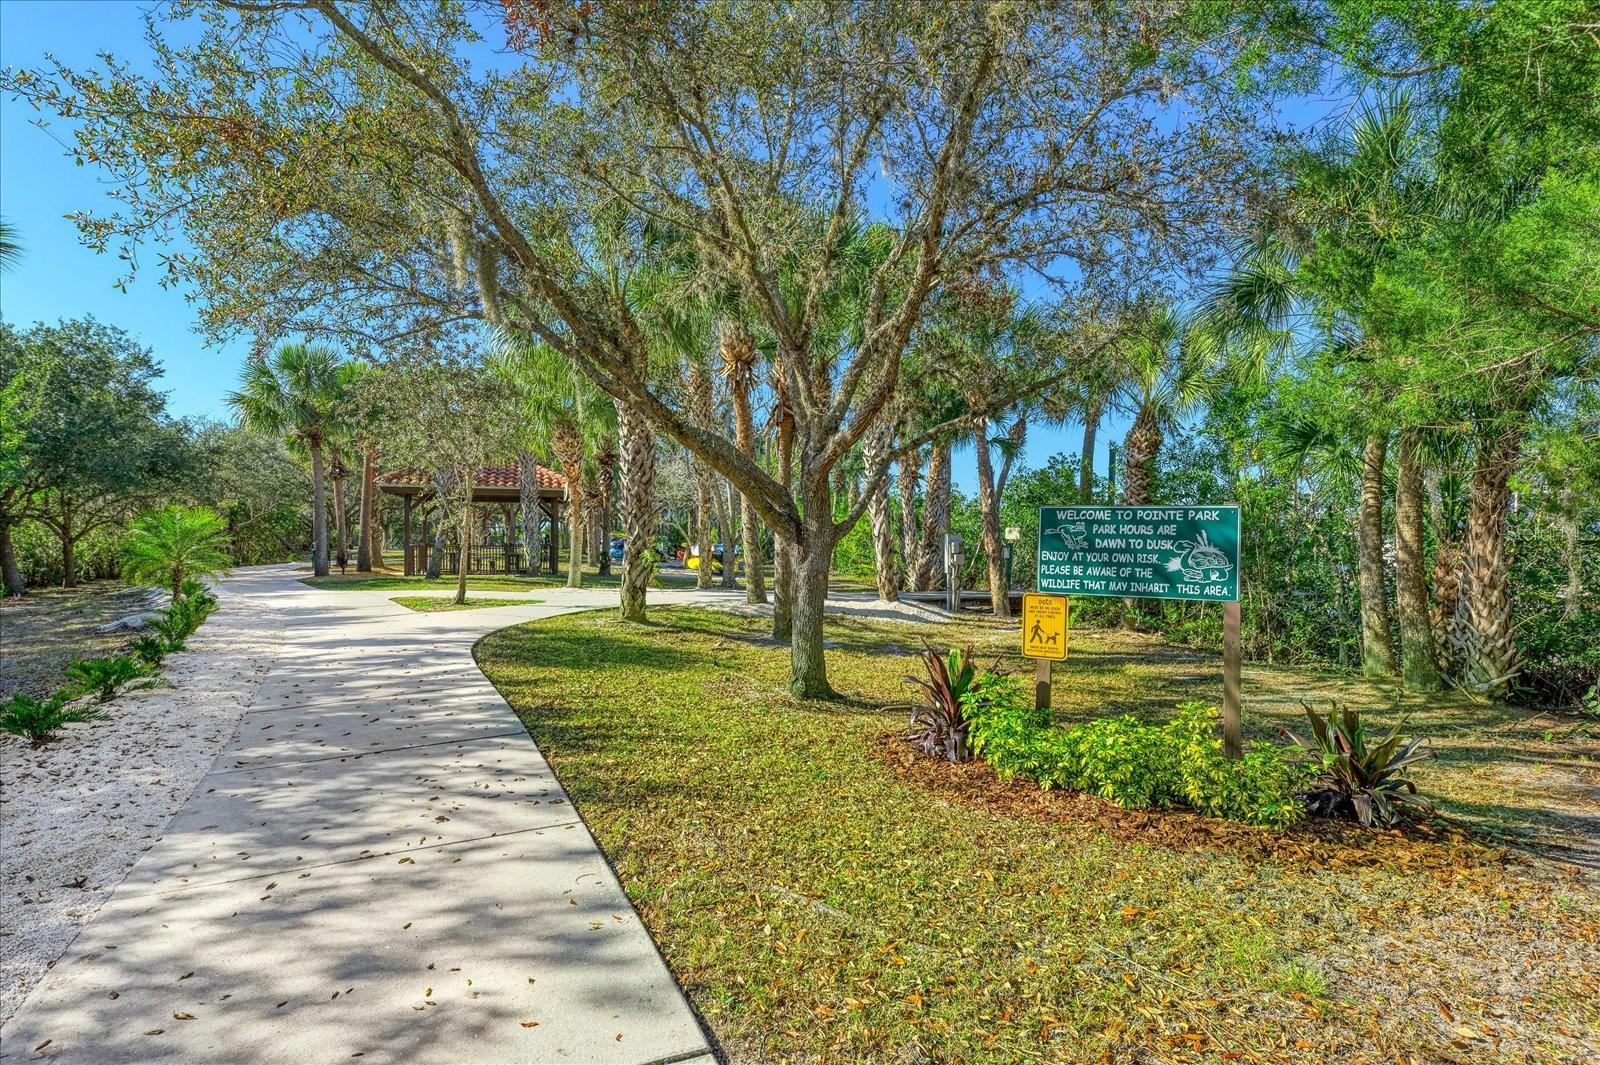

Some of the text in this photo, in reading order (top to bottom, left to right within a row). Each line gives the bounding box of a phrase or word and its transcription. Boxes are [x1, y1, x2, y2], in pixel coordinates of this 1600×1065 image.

[1056, 510, 1220, 520] WELCOME TO POINTE PARK
[1092, 524, 1177, 535] PARK HOURS ARE
[1095, 538, 1126, 549] DAWN
[1129, 539, 1143, 549] TO
[1042, 551, 1161, 564] ENJOY AT YOUR OWN RISK.
[1041, 564, 1152, 578] PLEASE BE AWARE OF THE
[1041, 578, 1232, 597] WILDLIFE THAT MAY INHABIT THIS AREA.
